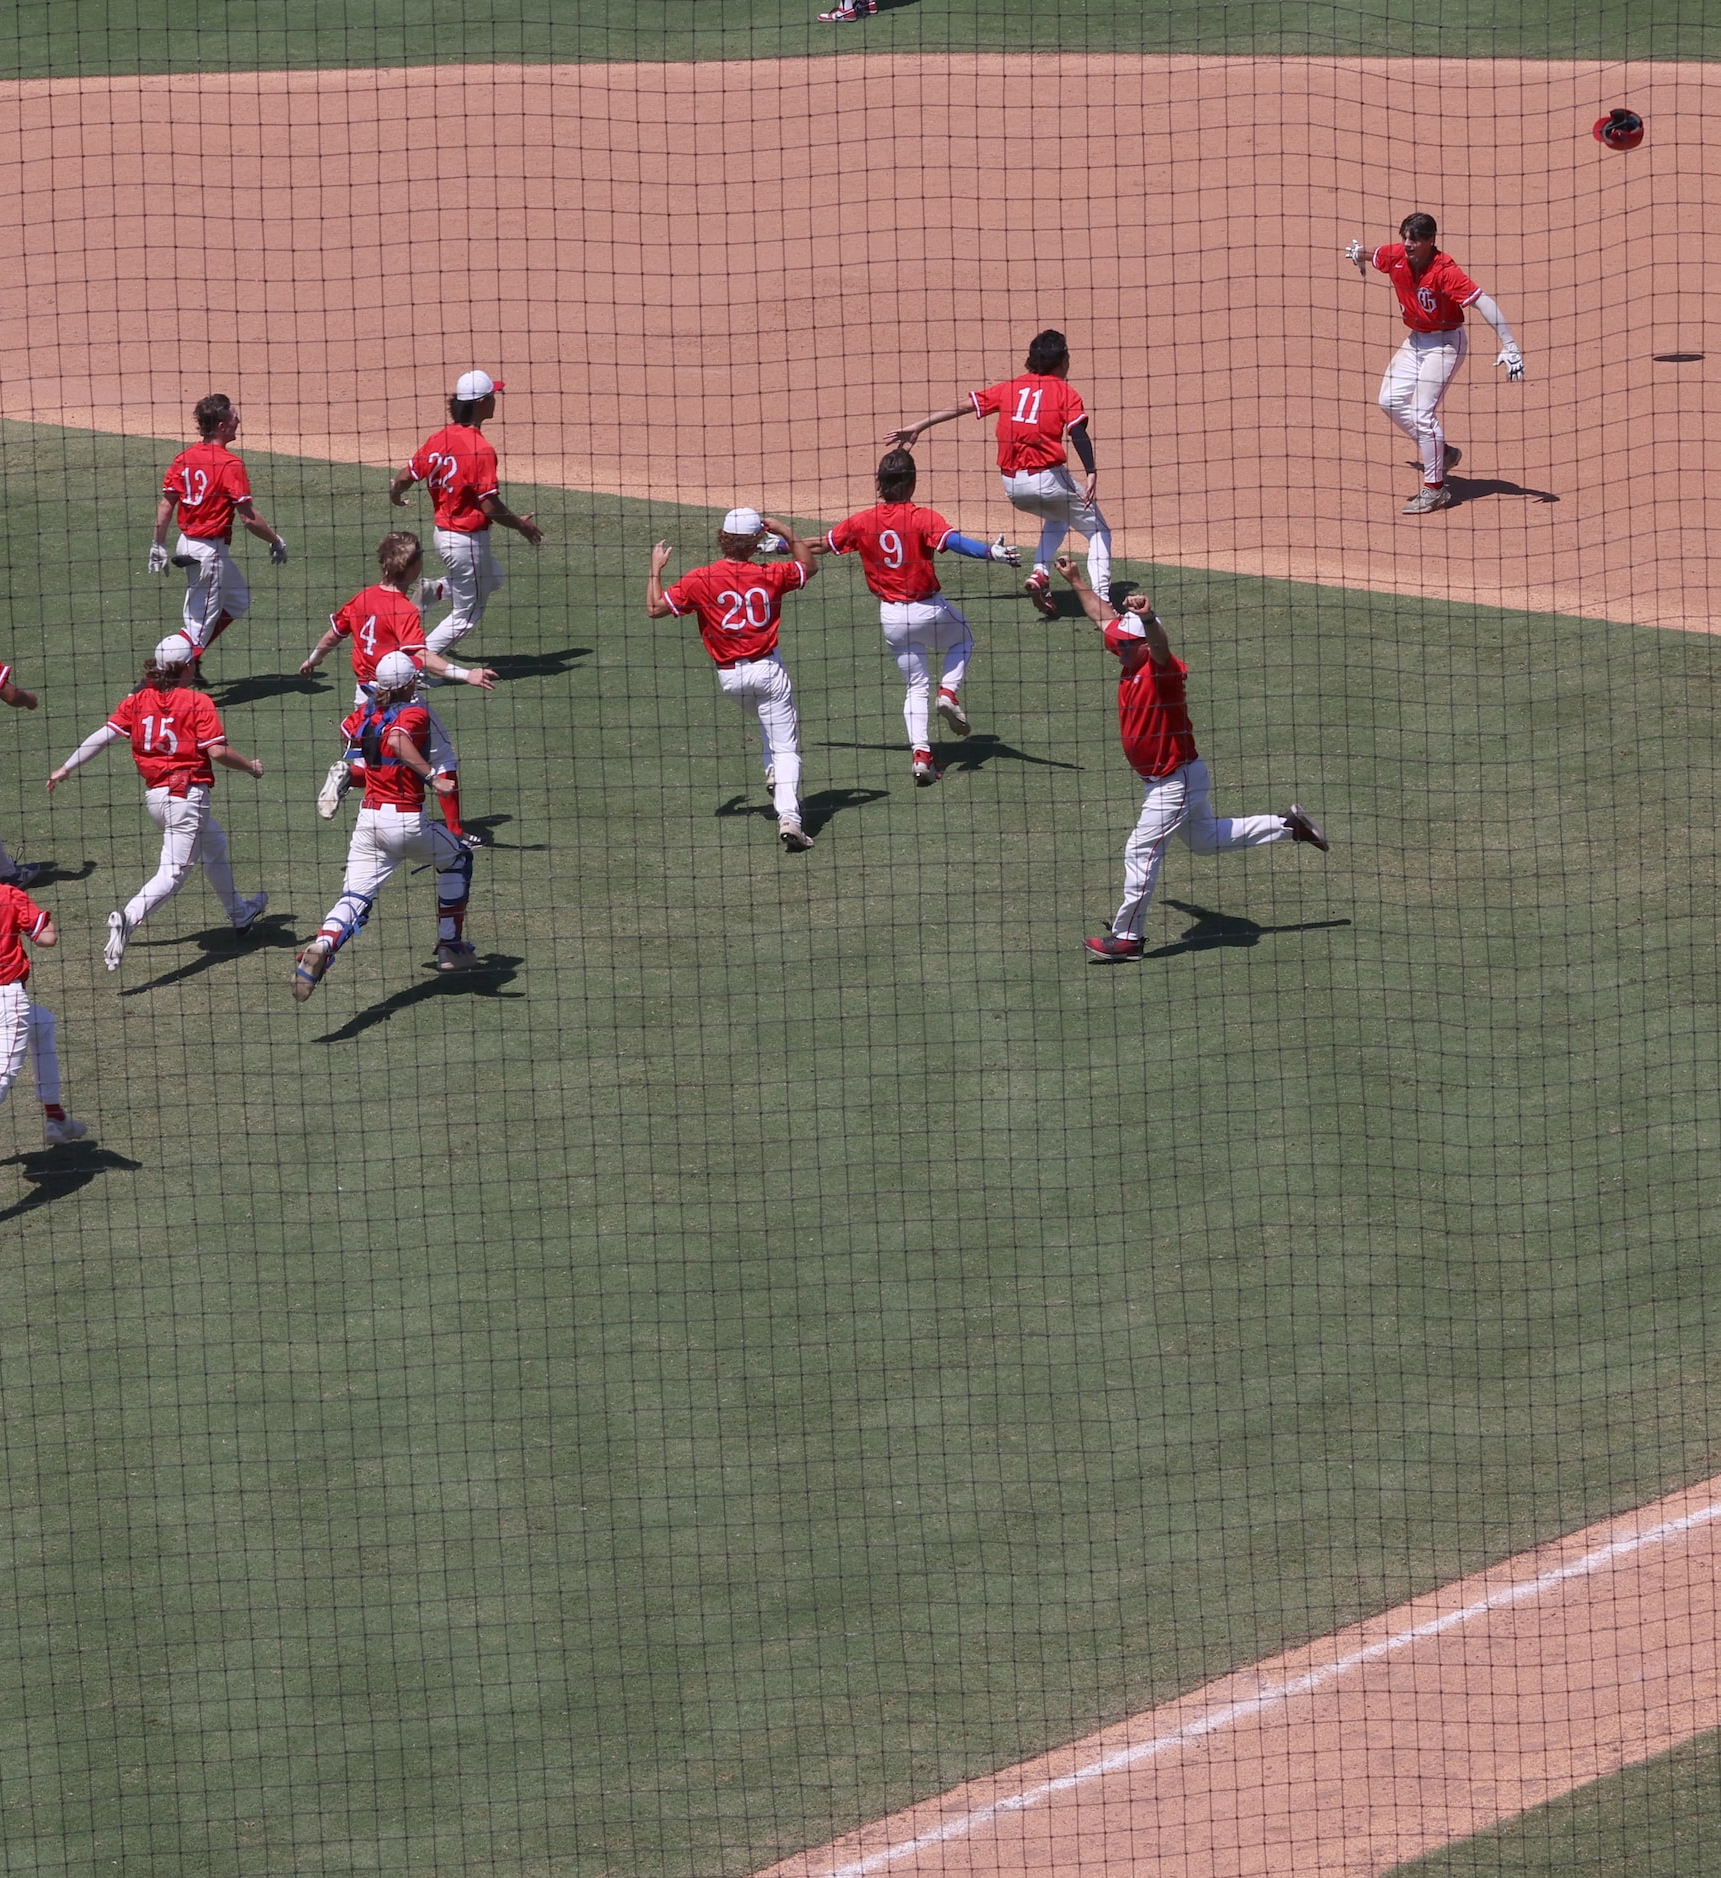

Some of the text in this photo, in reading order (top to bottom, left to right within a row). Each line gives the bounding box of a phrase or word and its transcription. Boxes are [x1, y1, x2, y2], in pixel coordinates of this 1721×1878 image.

[1011, 387, 1043, 425] 11
[181, 466, 208, 506] 13
[428, 451, 458, 494] 22
[879, 529, 904, 569] 9
[716, 586, 771, 631] 20
[359, 615, 378, 656] 4
[141, 714, 179, 756] 15
